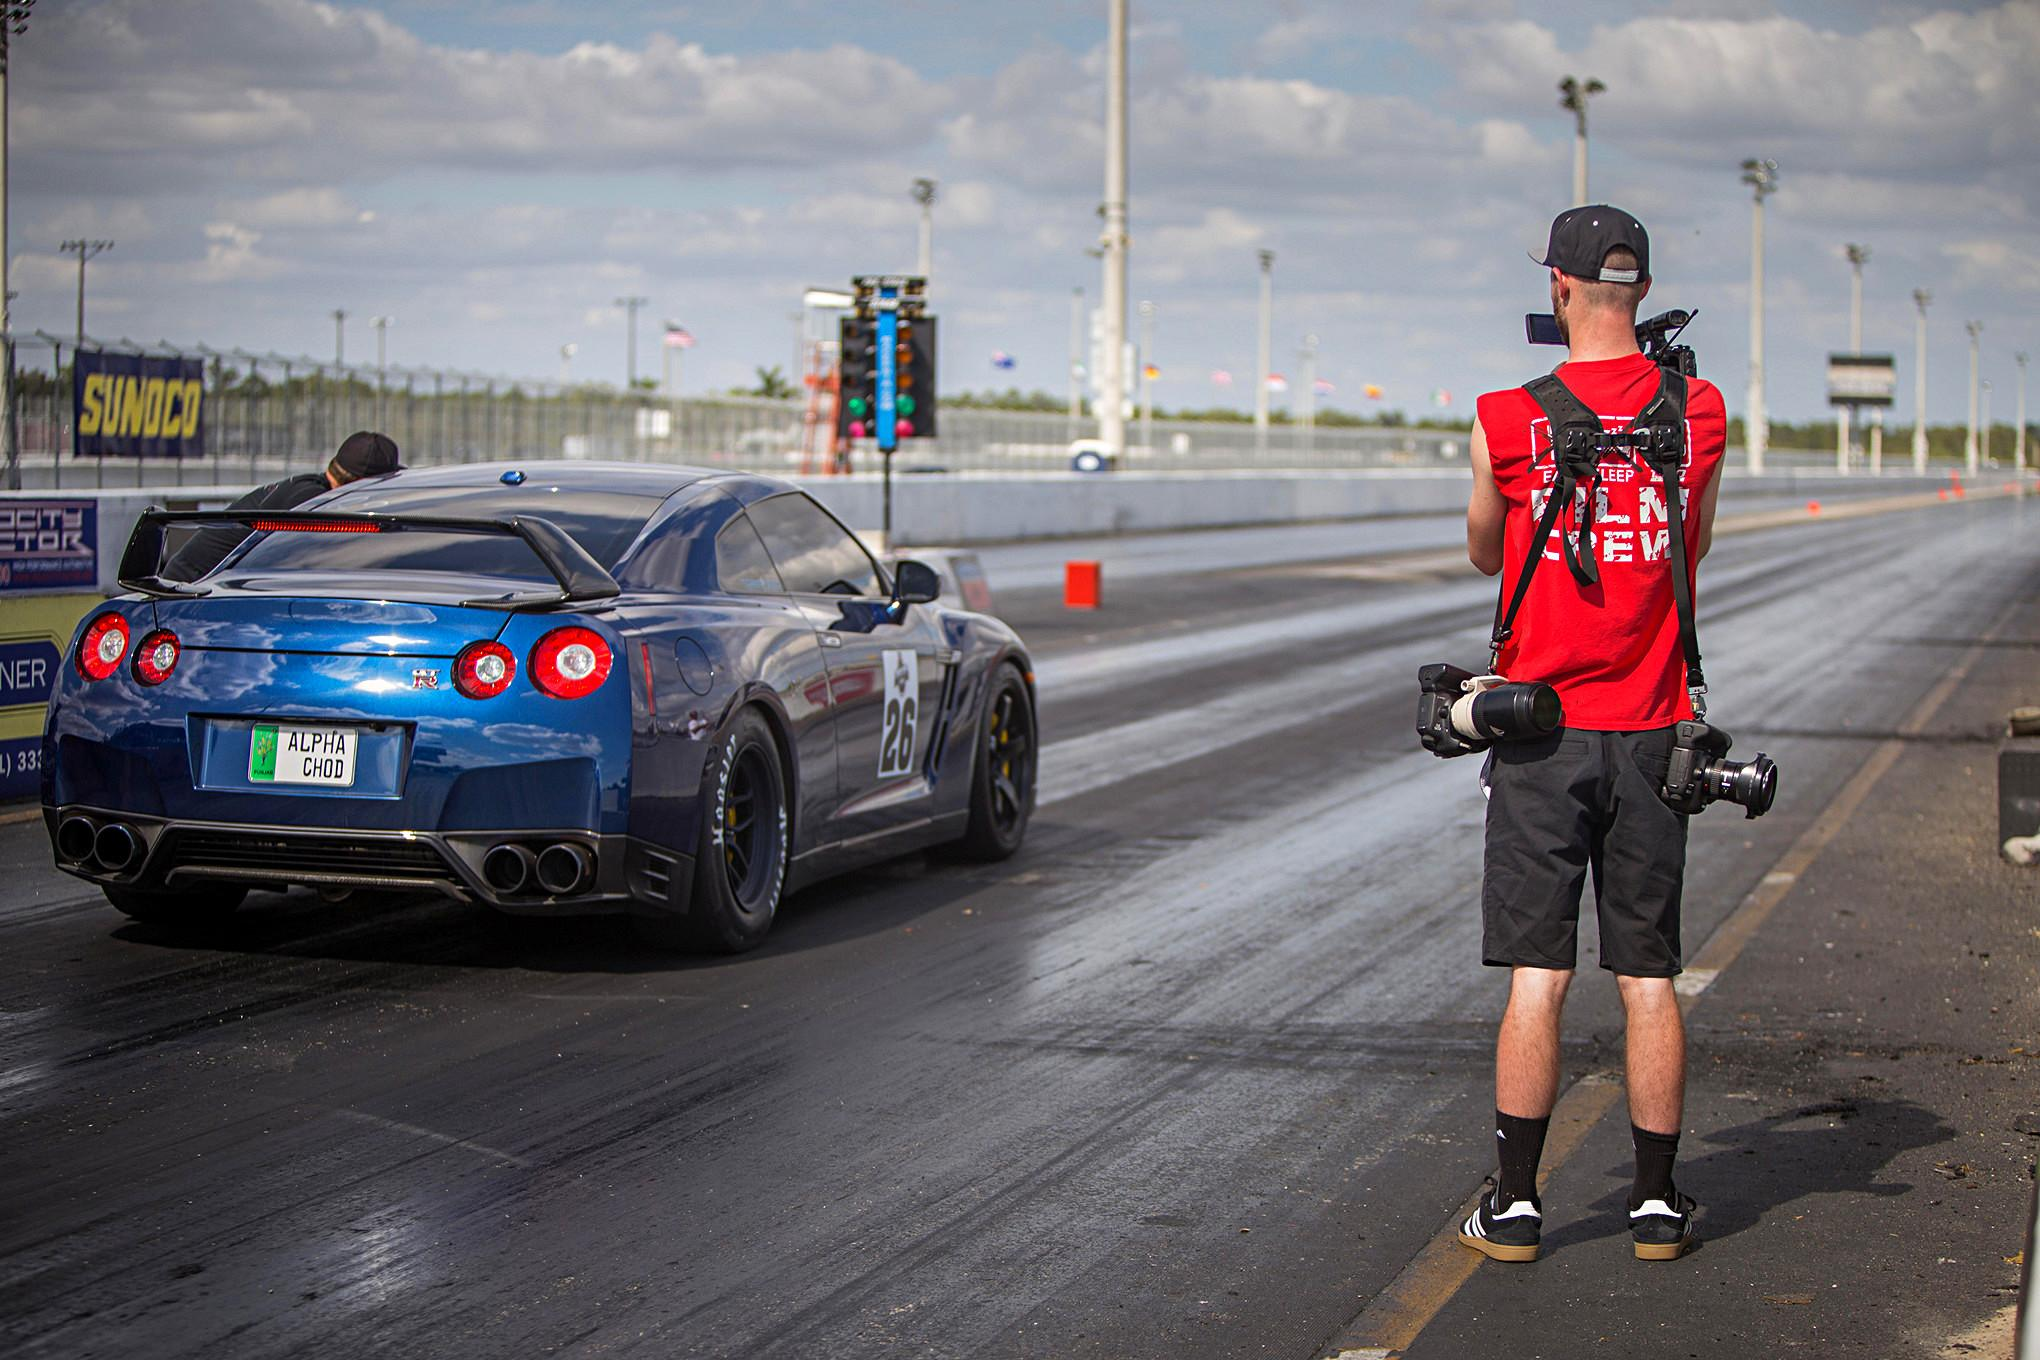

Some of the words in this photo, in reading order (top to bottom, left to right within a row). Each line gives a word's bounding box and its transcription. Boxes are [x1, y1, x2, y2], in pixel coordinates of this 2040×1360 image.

[79, 373, 200, 440] SUNOCO
[1592, 469, 1634, 483] LEEP
[287, 731, 345, 755] ALPHA
[880, 698, 915, 772] 26
[303, 757, 344, 779] CHOD
